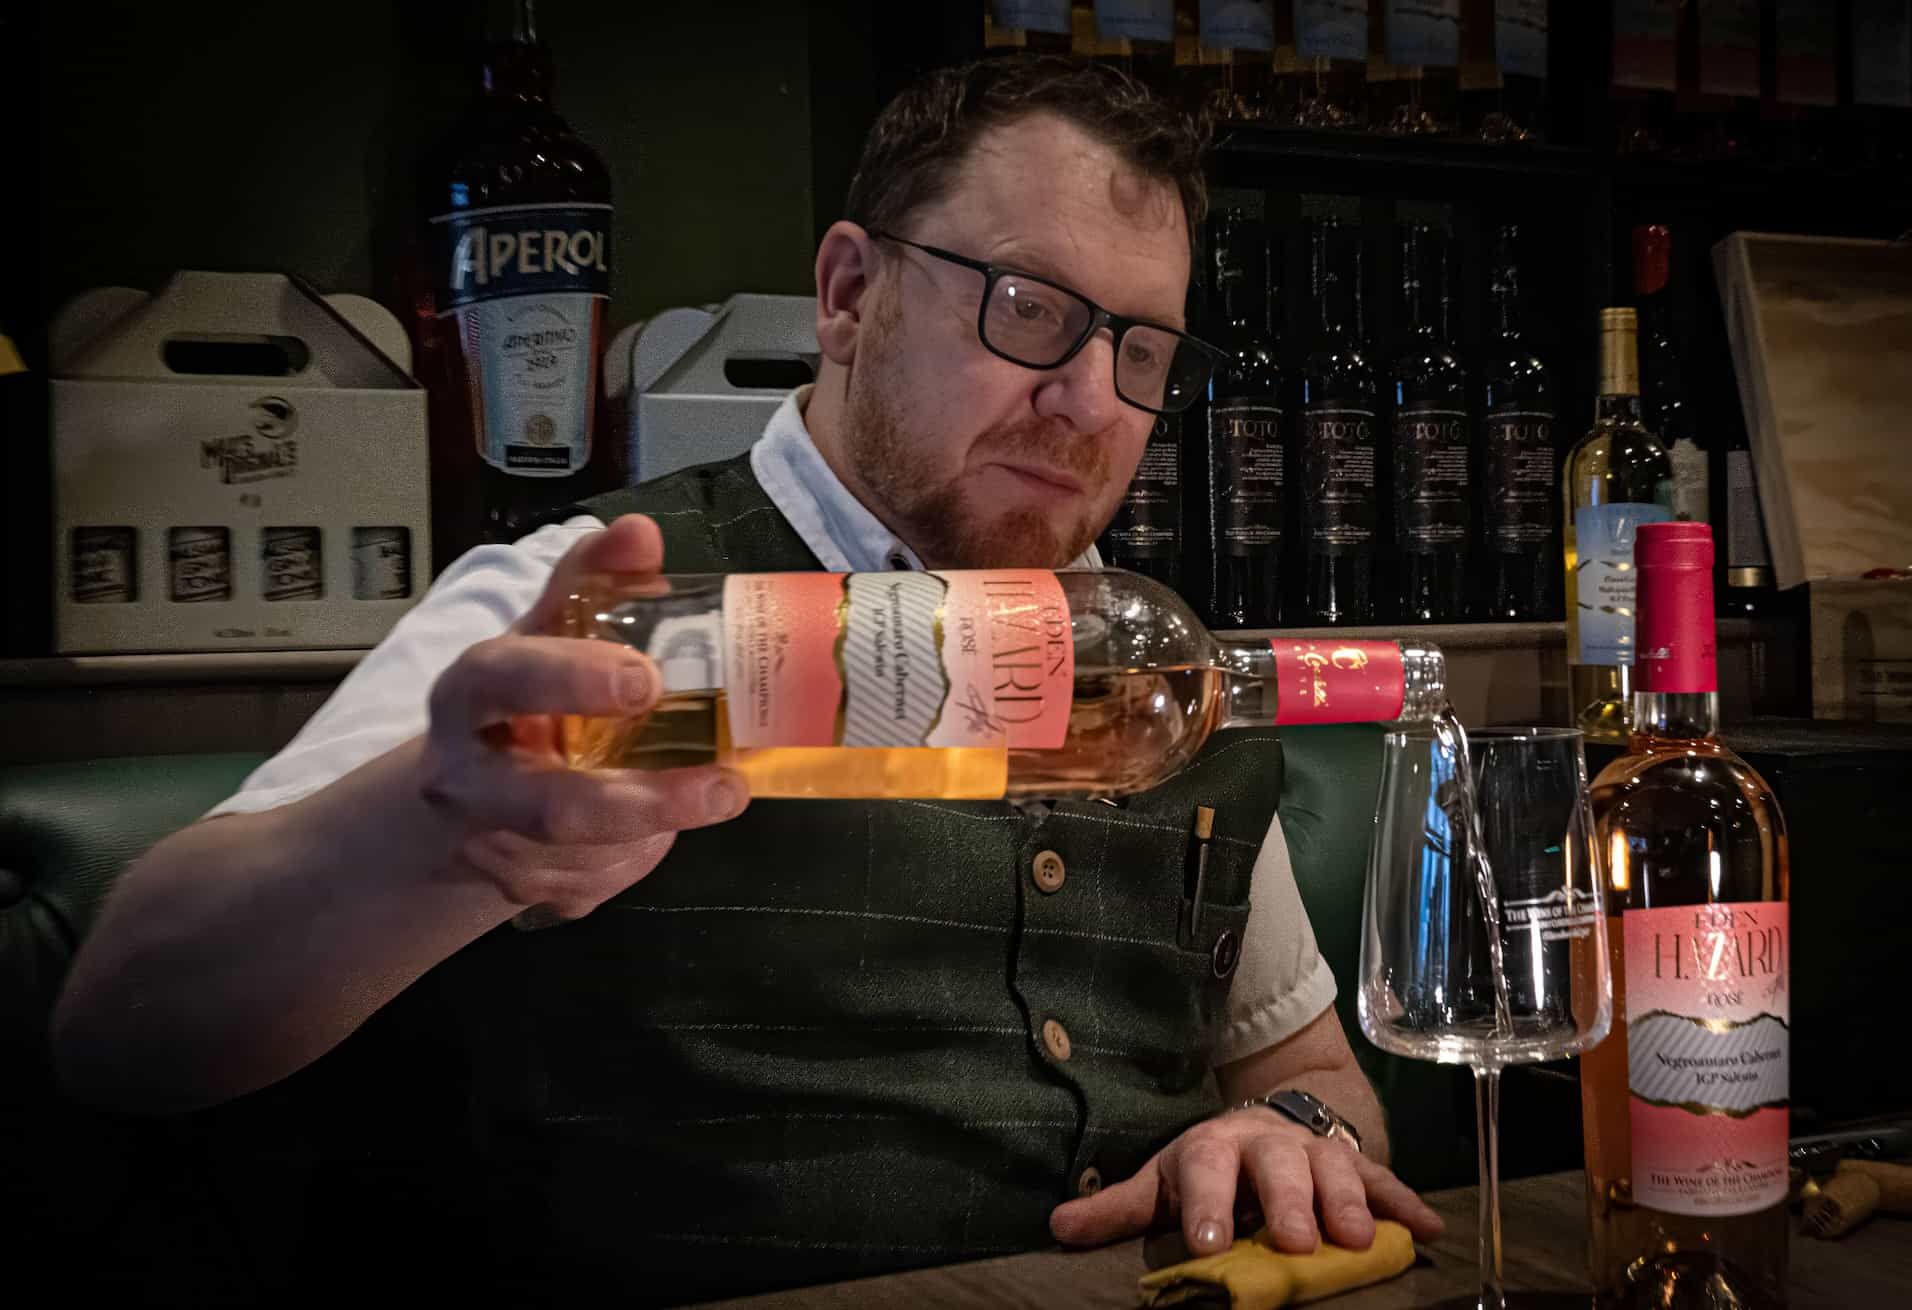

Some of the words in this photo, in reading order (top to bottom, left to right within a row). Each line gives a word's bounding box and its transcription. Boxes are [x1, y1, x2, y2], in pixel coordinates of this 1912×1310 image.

[452, 226, 607, 289] APEROL
[755, 633, 768, 654] THE
[984, 581, 1043, 724] HAZARD
[1505, 909, 1526, 921] THE
[1655, 926, 1782, 979] HAZARD
[1674, 1175, 1702, 1186] WINE
